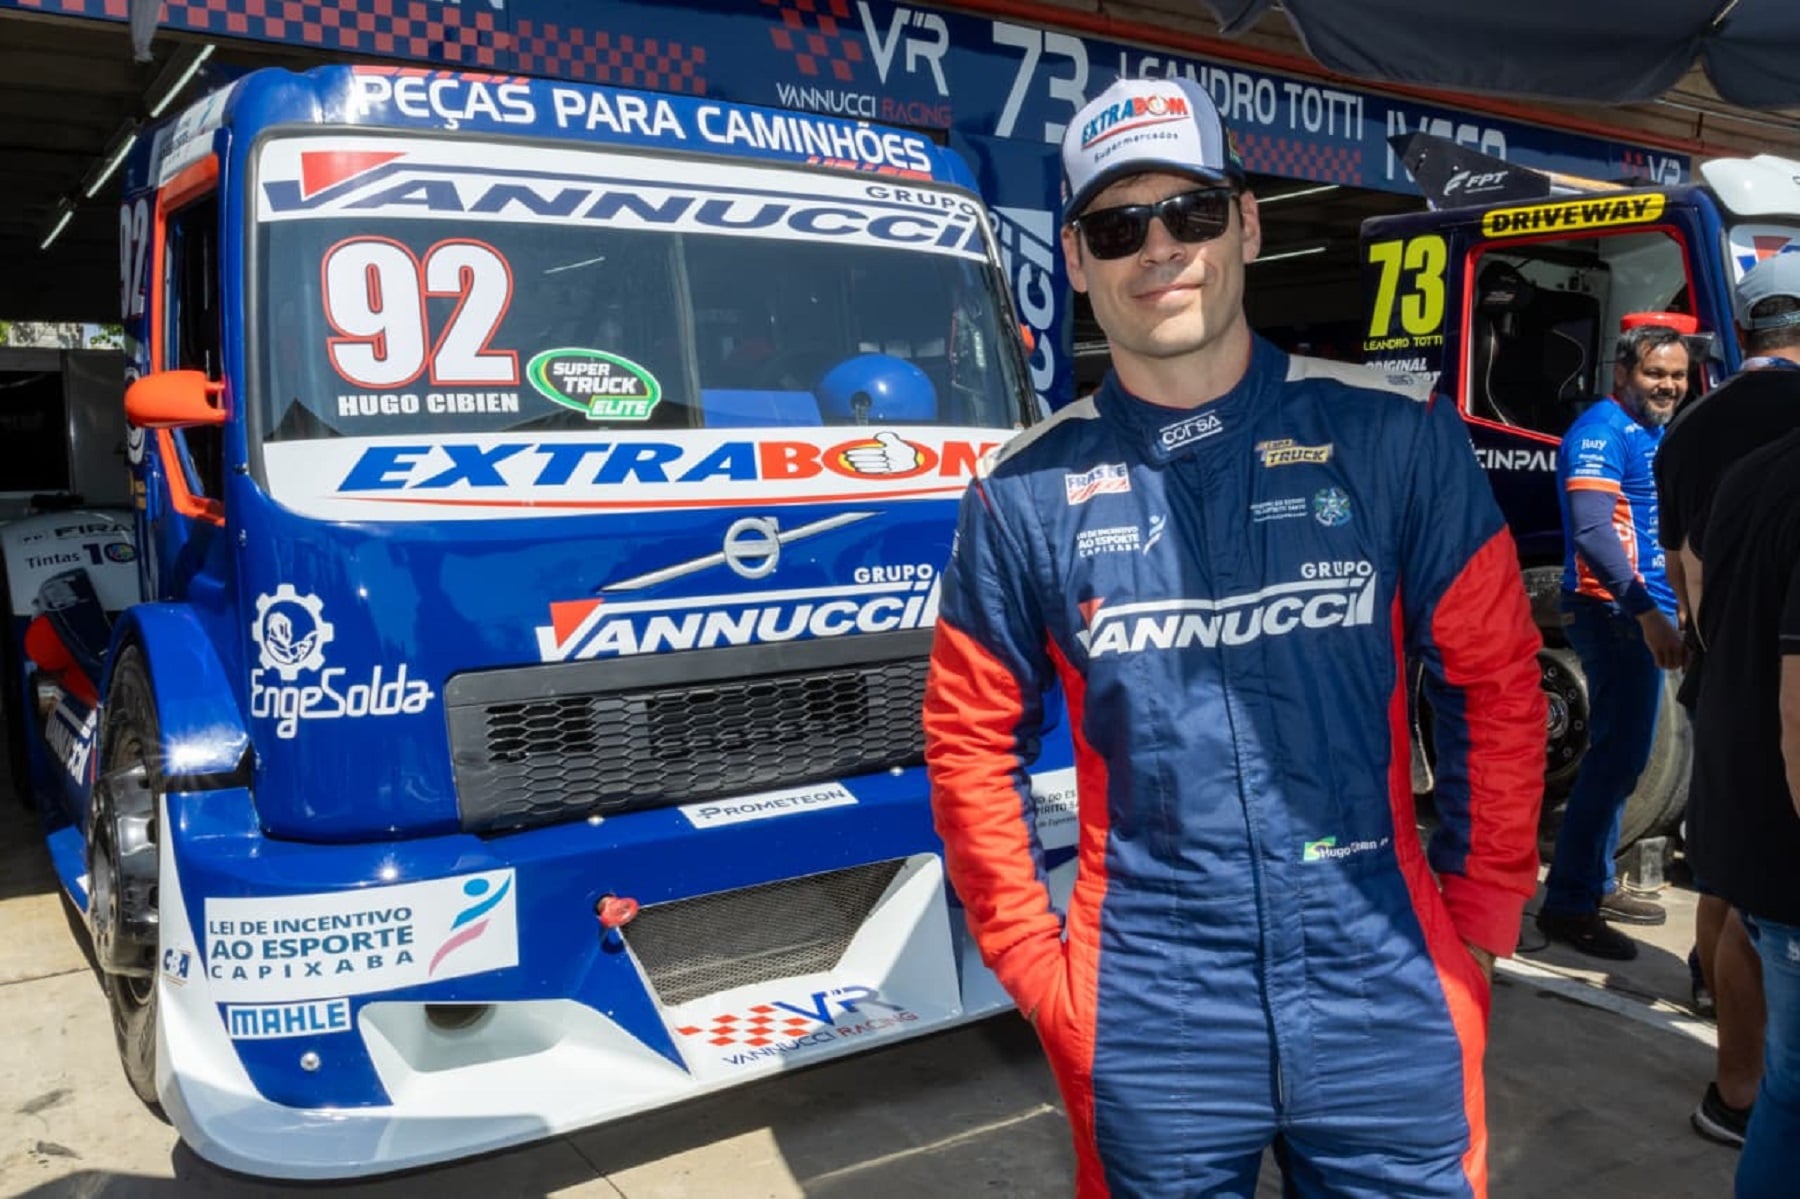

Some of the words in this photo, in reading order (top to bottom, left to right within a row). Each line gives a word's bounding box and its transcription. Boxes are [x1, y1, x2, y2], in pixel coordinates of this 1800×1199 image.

[993, 21, 1089, 144] 73
[776, 82, 877, 119] VANNUCCI
[881, 98, 954, 127] RACING
[1284, 82, 1364, 141] TOTTI
[353, 75, 536, 130] PEÇAS
[552, 87, 687, 139] PARA
[696, 105, 932, 173] CAMINHÕES
[1080, 95, 1189, 146] EXTRABOM
[1465, 170, 1509, 188] FPT
[865, 185, 979, 217] GRUPO
[1491, 197, 1652, 234] DRIVEWAY
[1368, 233, 1448, 338] 73
[320, 234, 520, 390] 92
[1363, 338, 1410, 351] LEANDRO
[1412, 335, 1443, 347] TOTTI
[552, 362, 611, 376] SUPER
[563, 376, 637, 394] TRUCK
[338, 393, 419, 417] HUGO
[427, 392, 519, 414] CIBIEN
[592, 400, 649, 416] ELITE
[1270, 449, 1325, 463] TRUCK
[26, 552, 80, 569] Tintas
[854, 563, 933, 585] GRUPO
[1301, 561, 1373, 579] GRUPO
[250, 663, 434, 739] EngeSolda
[698, 789, 846, 819] PROMETEON
[1320, 846, 1351, 859] Hugo
[209, 921, 234, 936] LEI
[240, 920, 267, 936] DE
[273, 907, 412, 934] INCENTIVO
[211, 940, 254, 961] AO
[262, 925, 413, 960] ESPORTE
[210, 950, 414, 980] CAPIXABA
[231, 1002, 347, 1036] MAHLE
[722, 1030, 836, 1065] VANNUCCI
[836, 1011, 918, 1038] RACING
